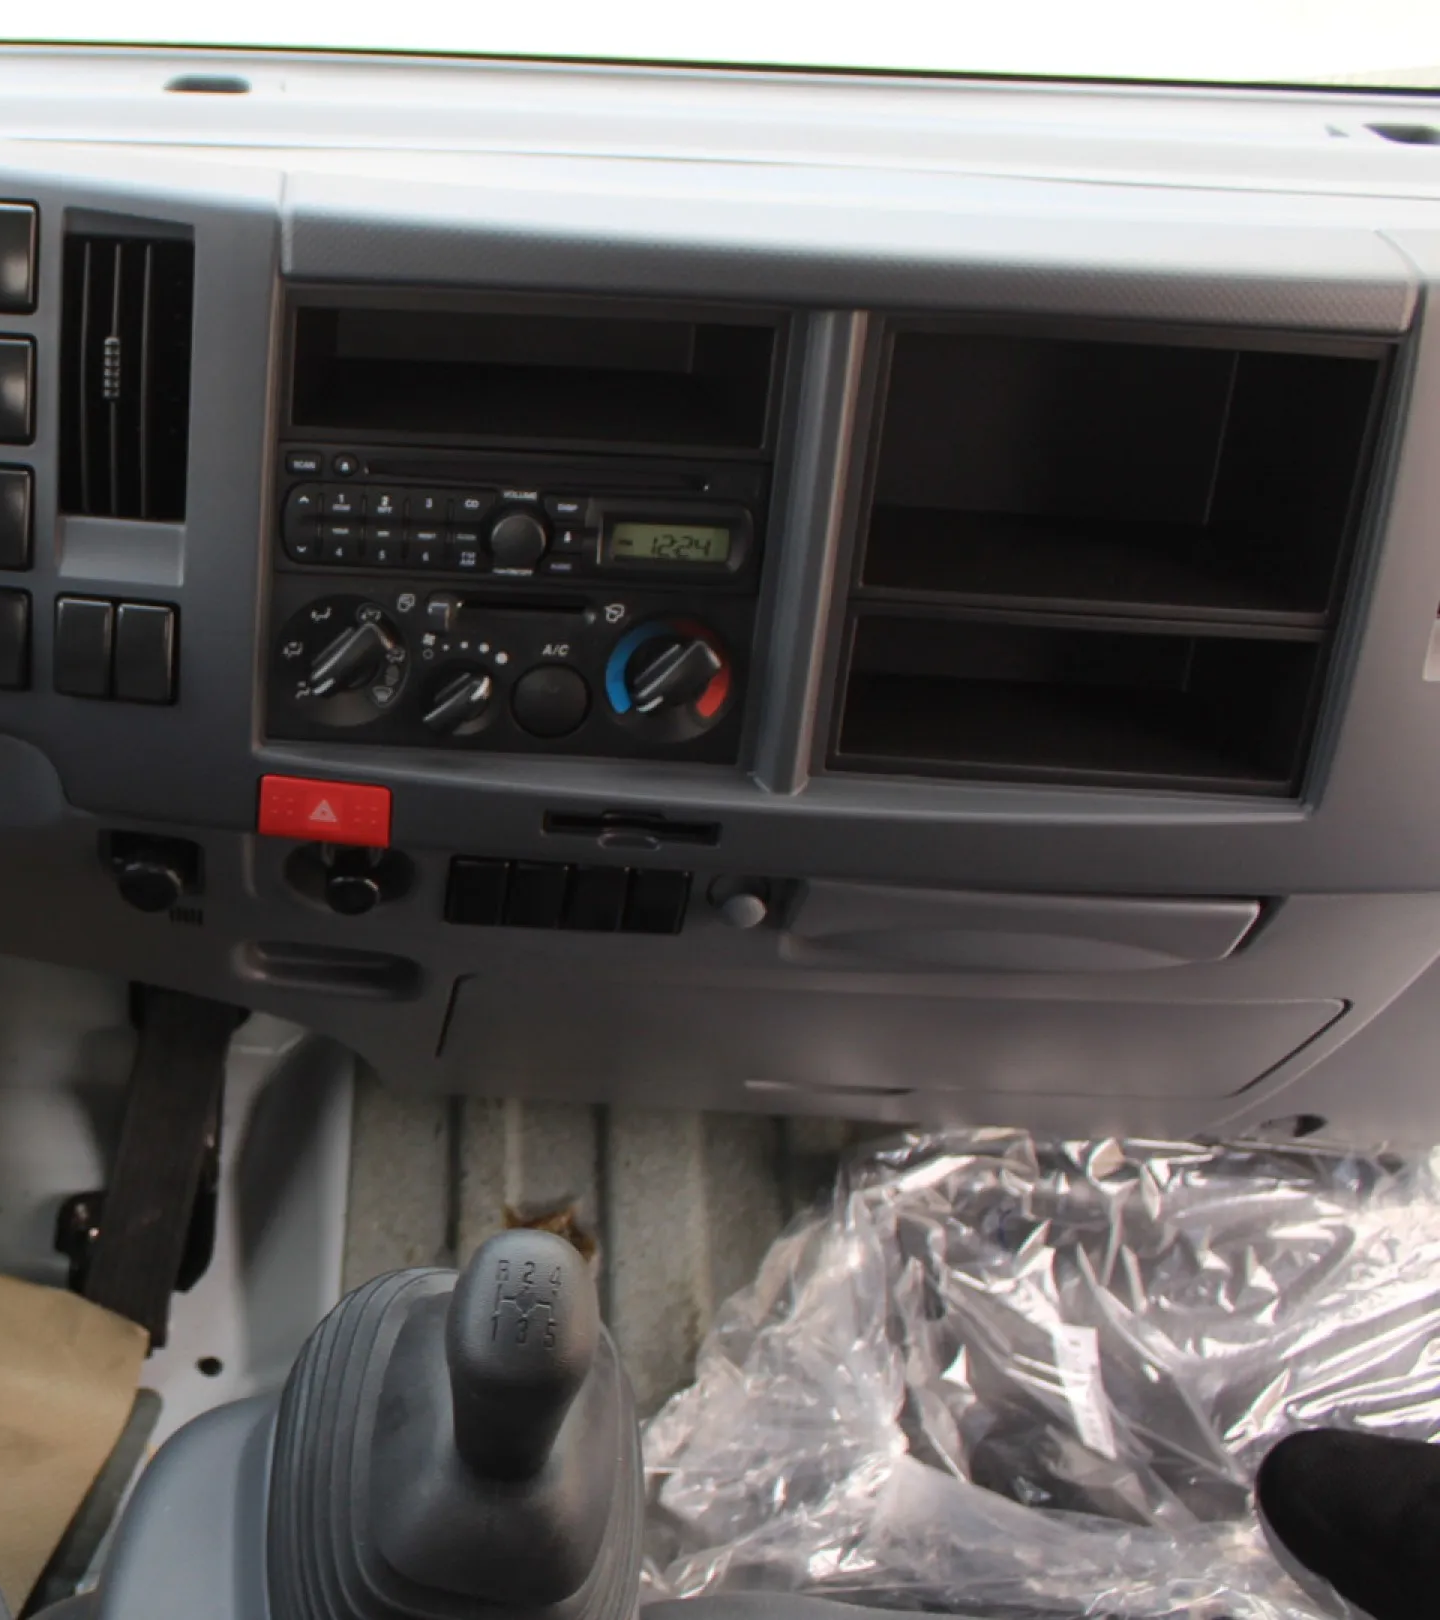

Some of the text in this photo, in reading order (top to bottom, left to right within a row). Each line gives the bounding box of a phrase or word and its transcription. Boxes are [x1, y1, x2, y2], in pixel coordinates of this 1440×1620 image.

[464, 499, 480, 509] CD
[542, 644, 570, 657] A/C
[523, 1261, 536, 1284] 2
